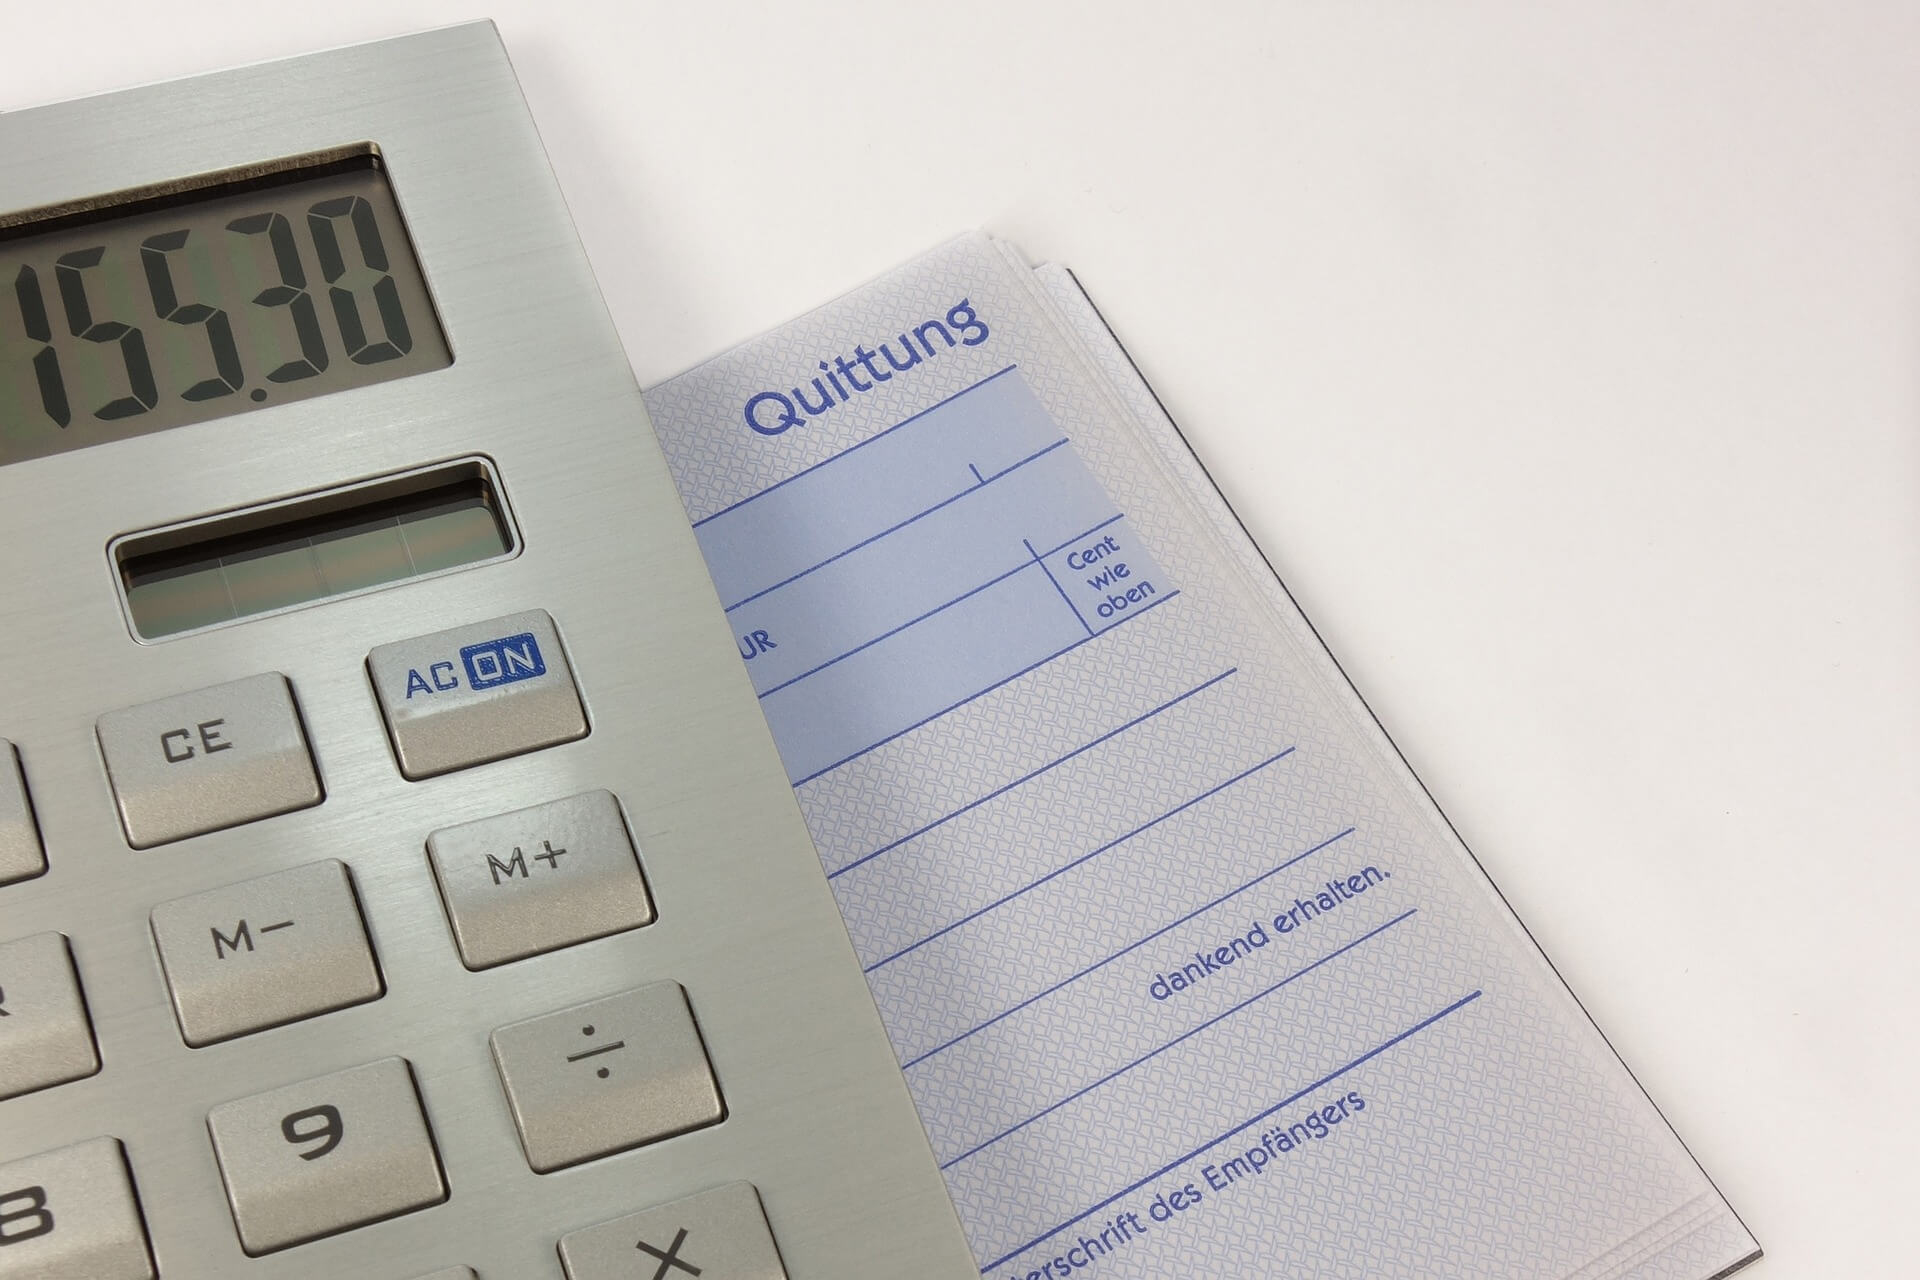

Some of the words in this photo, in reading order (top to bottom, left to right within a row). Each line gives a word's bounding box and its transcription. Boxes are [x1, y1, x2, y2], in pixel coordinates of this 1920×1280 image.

[15, 194, 413, 429] 155.30
[743, 297, 990, 436] Quittung
[1066, 535, 1120, 570] Cent
[1086, 563, 1131, 591] wie
[1097, 581, 1155, 617] oben
[406, 661, 459, 699] AC
[468, 640, 539, 684] ON
[742, 629, 778, 660] UR
[160, 718, 233, 764] CE
[486, 839, 567, 885] M+
[210, 919, 295, 959] M-
[1150, 922, 1270, 1001] dankend
[1272, 866, 1391, 934] erhalten.
[281, 1104, 344, 1161] 9
[1010, 1211, 1148, 1280] erschrift
[1149, 1180, 1203, 1223] des
[1201, 1090, 1367, 1194] Empfängers
[0, 1185, 54, 1247] 8
